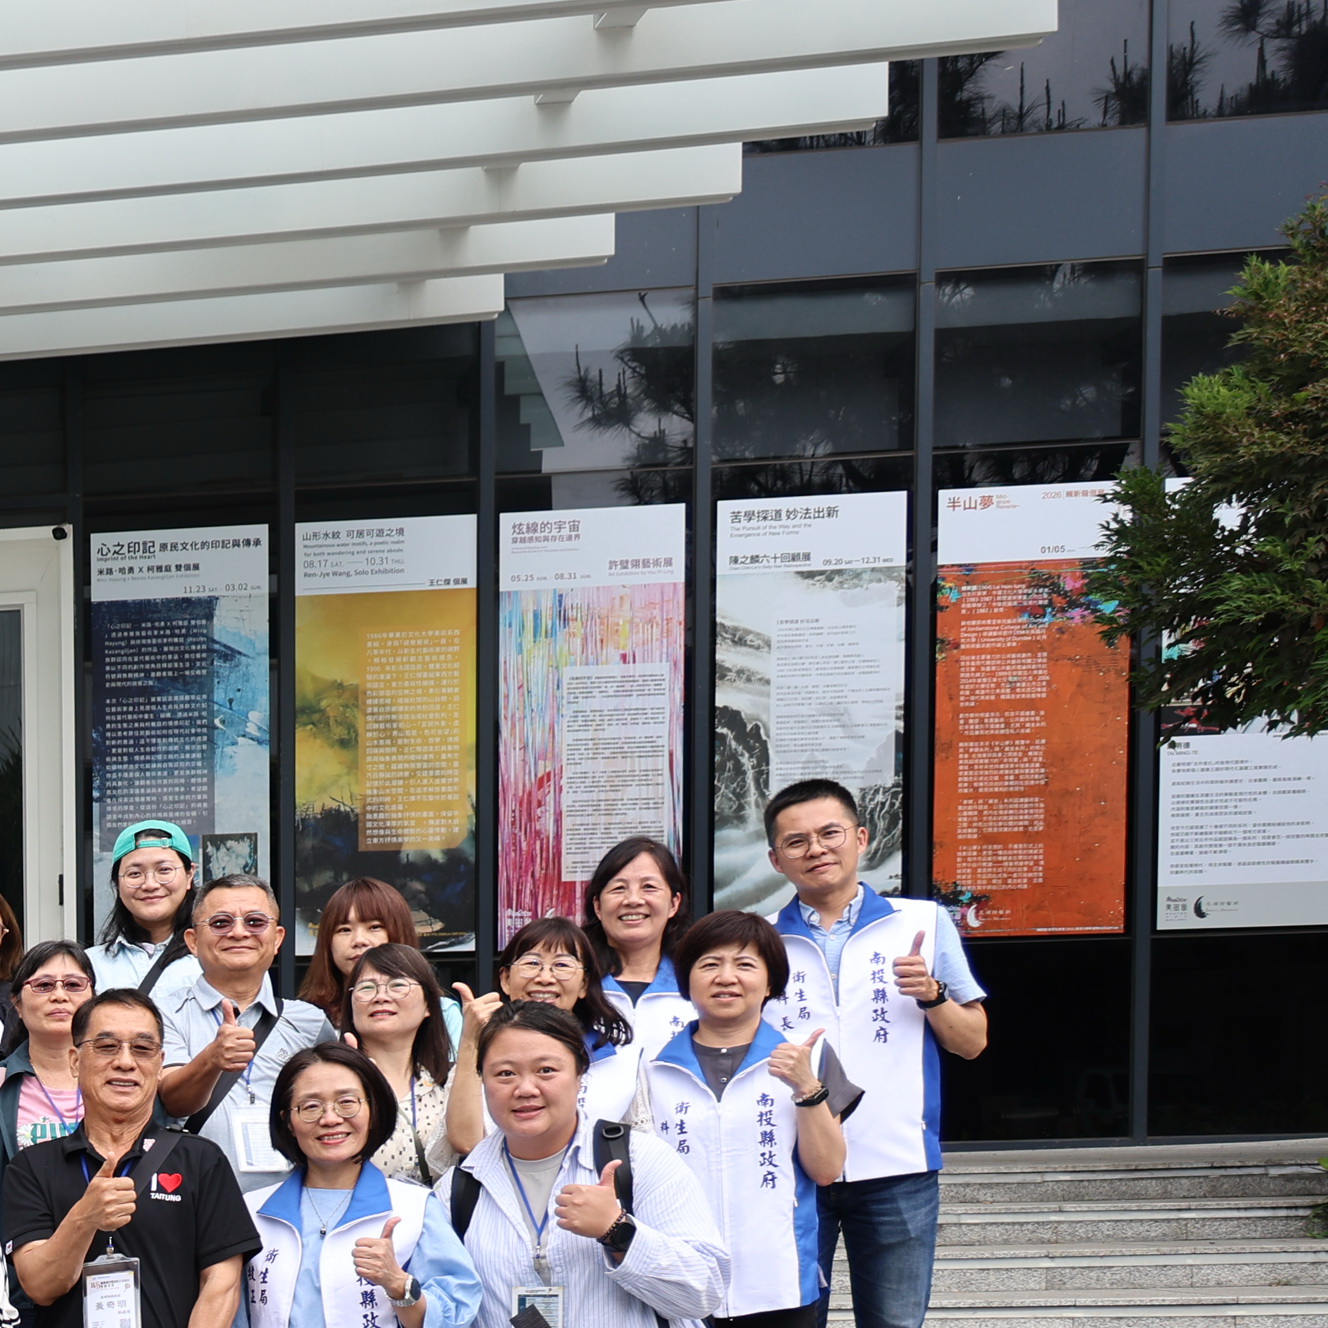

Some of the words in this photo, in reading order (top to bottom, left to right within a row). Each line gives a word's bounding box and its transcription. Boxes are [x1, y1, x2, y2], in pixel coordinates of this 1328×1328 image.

[946, 495, 994, 512] 半山夢
[1042, 492, 1062, 500] 2026
[730, 508, 783, 524] 苦學探道
[786, 505, 839, 521] 妙法出新
[302, 530, 341, 542] 山形水紋
[346, 527, 405, 539] 可居可遊之境
[511, 520, 580, 535] 炫線的宇宙
[96, 540, 156, 556] 心之印記
[1040, 546, 1065, 554] 01/05
[303, 559, 328, 569] 08.17
[365, 556, 389, 566] 10.31
[861, 556, 880, 564] 12.31
[332, 570, 352, 578] Wang,
[511, 574, 534, 582] 05.25
[554, 572, 577, 580] 08.31
[184, 585, 206, 594] 11.23
[225, 583, 248, 592] 03.02
[792, 970, 811, 1020] 衛生局
[869, 951, 891, 1044] 南投縣政府
[675, 1100, 691, 1155] 衛生局
[756, 1093, 780, 1189] 南投縣政府
[150, 1172, 158, 1192] I
[150, 1192, 182, 1202] TAITUNG
